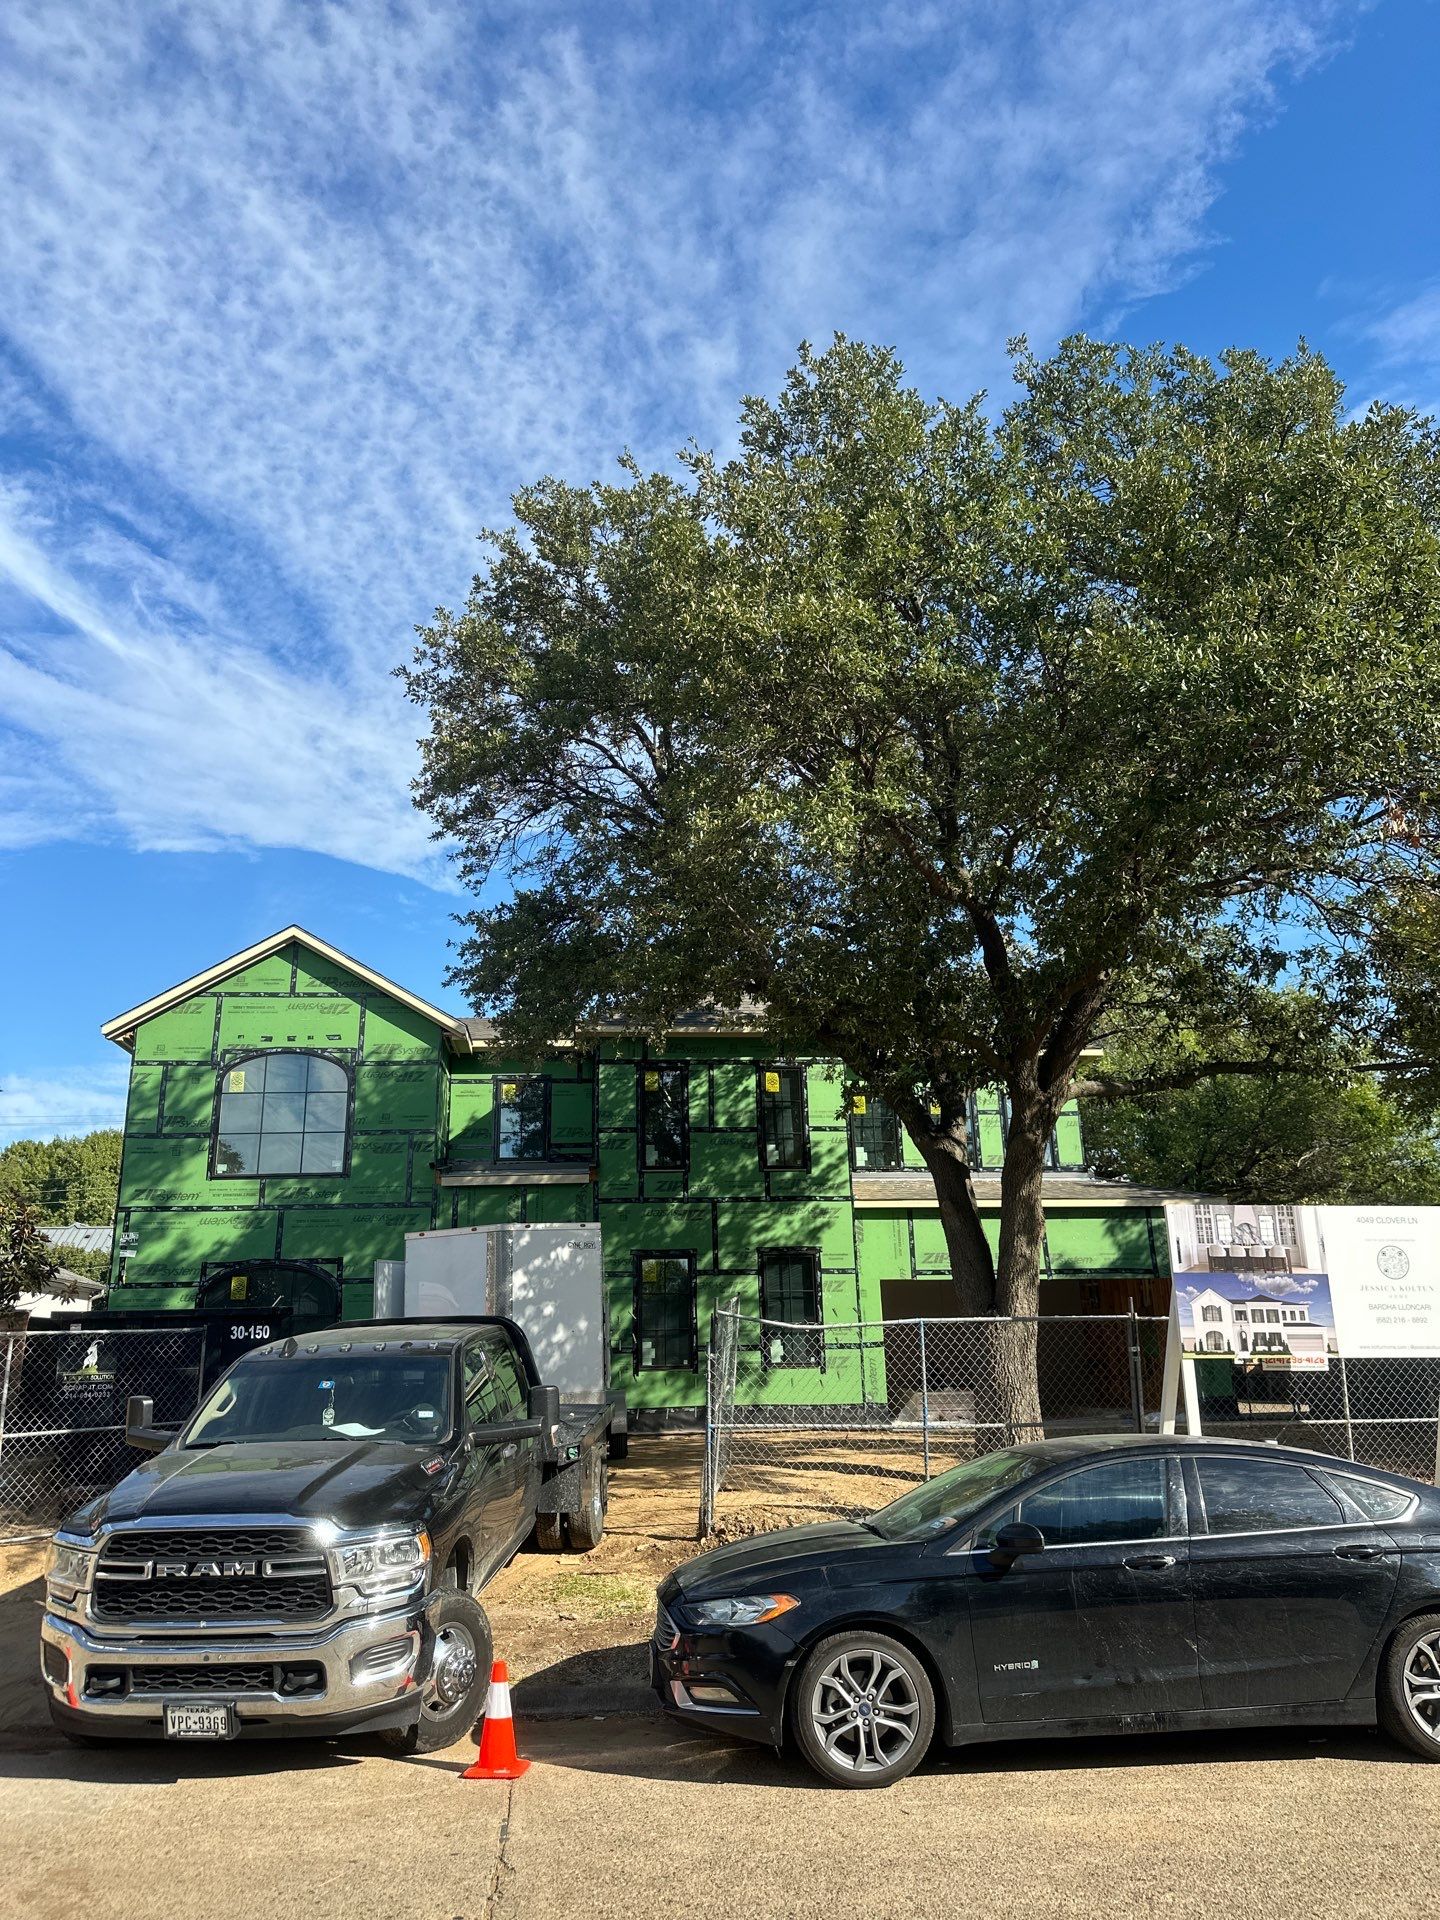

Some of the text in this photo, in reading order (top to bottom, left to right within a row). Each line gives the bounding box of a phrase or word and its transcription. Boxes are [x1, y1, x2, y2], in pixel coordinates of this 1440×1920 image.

[1356, 1216, 1374, 1224] 4049
[1376, 1216, 1405, 1224] CLOVER
[230, 1325, 270, 1340] 30-150
[156, 1561, 257, 1577] RAM
[993, 1662, 1031, 1672] HYBRID
